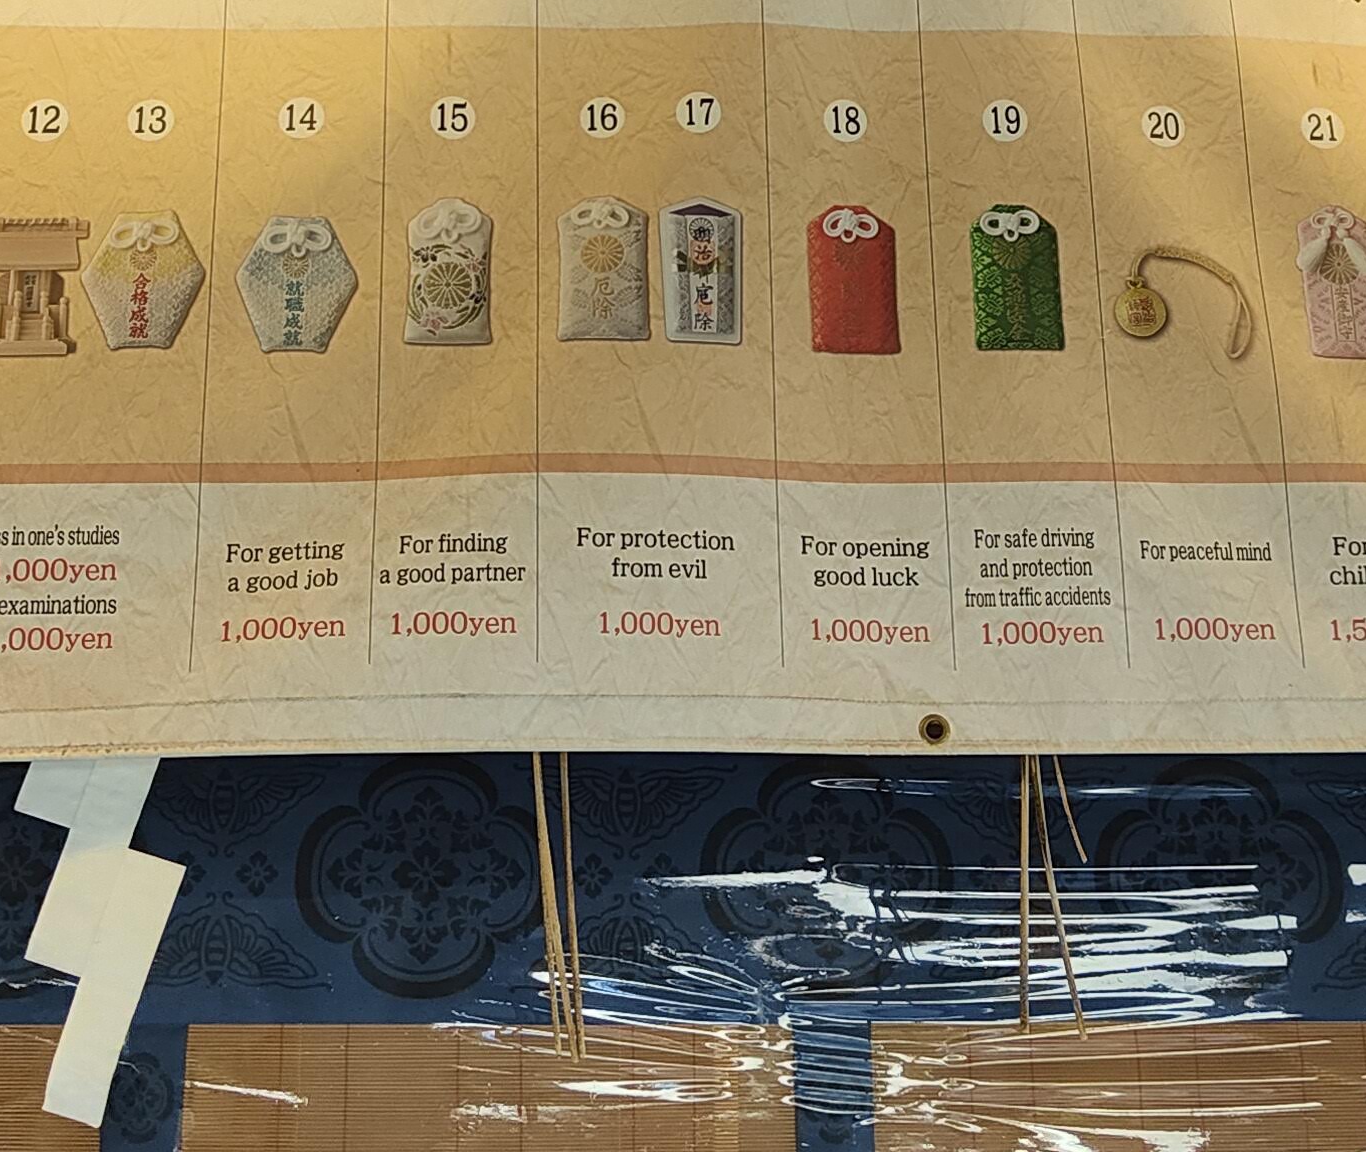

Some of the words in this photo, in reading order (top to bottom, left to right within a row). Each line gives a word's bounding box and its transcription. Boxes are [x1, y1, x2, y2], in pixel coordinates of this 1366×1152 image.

[27, 105, 61, 134] 12
[134, 105, 167, 135] 13
[285, 103, 317, 132] 14
[437, 101, 468, 132] 15
[587, 103, 618, 132] 16
[685, 98, 715, 126] 17
[832, 105, 861, 136] 18
[991, 105, 1021, 135] 19
[1147, 111, 1180, 141] 20
[1307, 113, 1338, 142] 21
[129, 272, 151, 340] 合格成就
[10, 525, 26, 546] in
[27, 523, 65, 547] one's
[67, 524, 120, 546] studies
[398, 534, 434, 555] For
[437, 532, 509, 555] finding
[576, 526, 616, 548] For
[619, 529, 736, 551] protection
[800, 534, 838, 557] For
[842, 537, 930, 560] opening
[973, 528, 1001, 550] For
[1003, 527, 1039, 549] safe
[1040, 527, 1095, 550] driving
[225, 543, 264, 564] For
[267, 540, 346, 563] getting
[1139, 539, 1167, 561] For
[1168, 540, 1234, 563] peaceful
[1235, 541, 1273, 562] mind
[227, 576, 241, 593] a
[245, 569, 299, 594] good
[303, 567, 339, 591] job
[379, 568, 391, 585] a
[396, 562, 446, 587] good
[450, 562, 527, 585] partner
[611, 556, 664, 578] from
[668, 558, 708, 580] evil
[813, 566, 867, 588] good
[871, 566, 920, 587] luck
[979, 557, 1010, 579] and
[1011, 555, 1094, 581] protection
[964, 587, 997, 608] from
[998, 586, 1043, 608] traffic
[1044, 585, 1112, 607] accidents
[220, 616, 346, 644] 1,000yen
[391, 611, 517, 637] 1,000yen
[599, 611, 721, 639] 1,000yen
[811, 618, 931, 646] 1,000yen
[981, 620, 1105, 647] 1,000yen
[1154, 617, 1277, 643] 1,000yen
